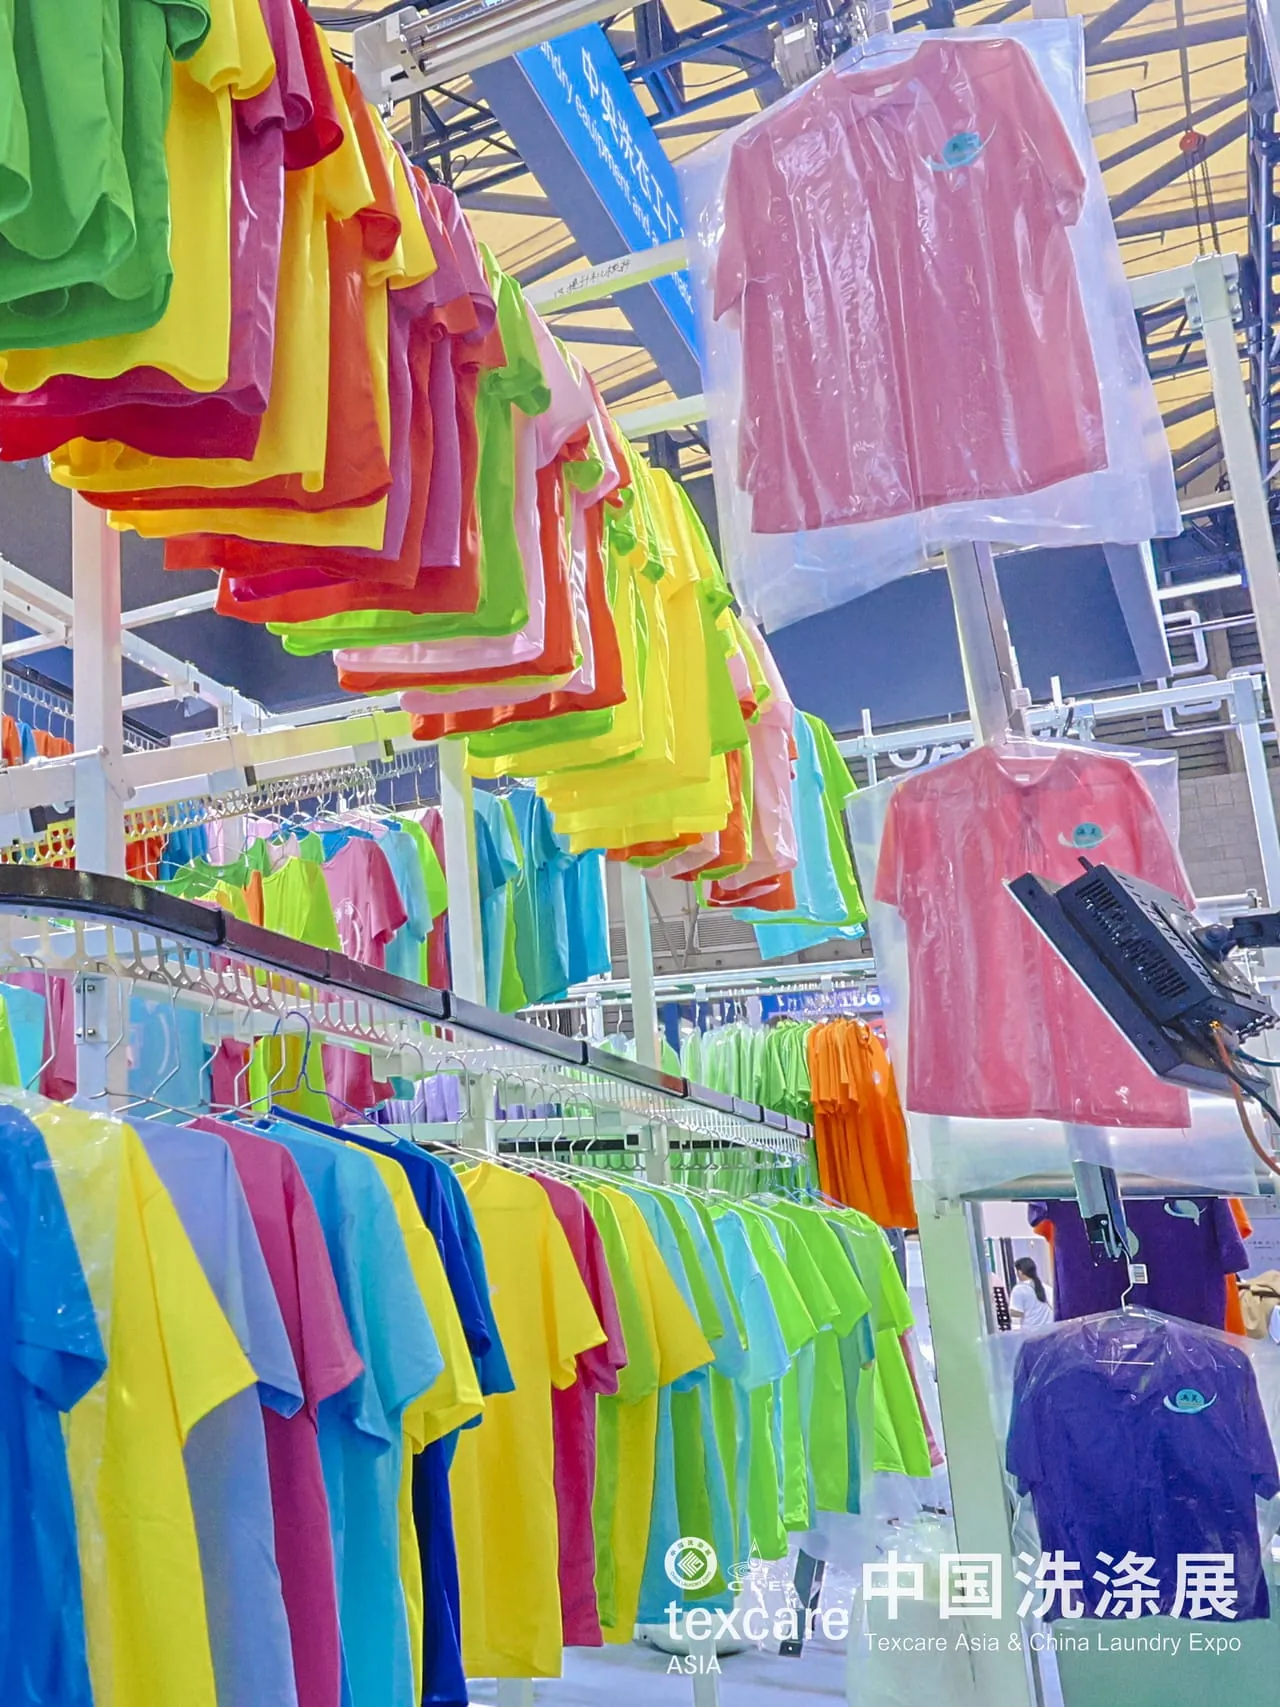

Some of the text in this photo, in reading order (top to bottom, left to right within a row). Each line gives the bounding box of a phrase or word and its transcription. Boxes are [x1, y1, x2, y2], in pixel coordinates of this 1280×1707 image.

[581, 46, 685, 239] 中央洗衣工厂
